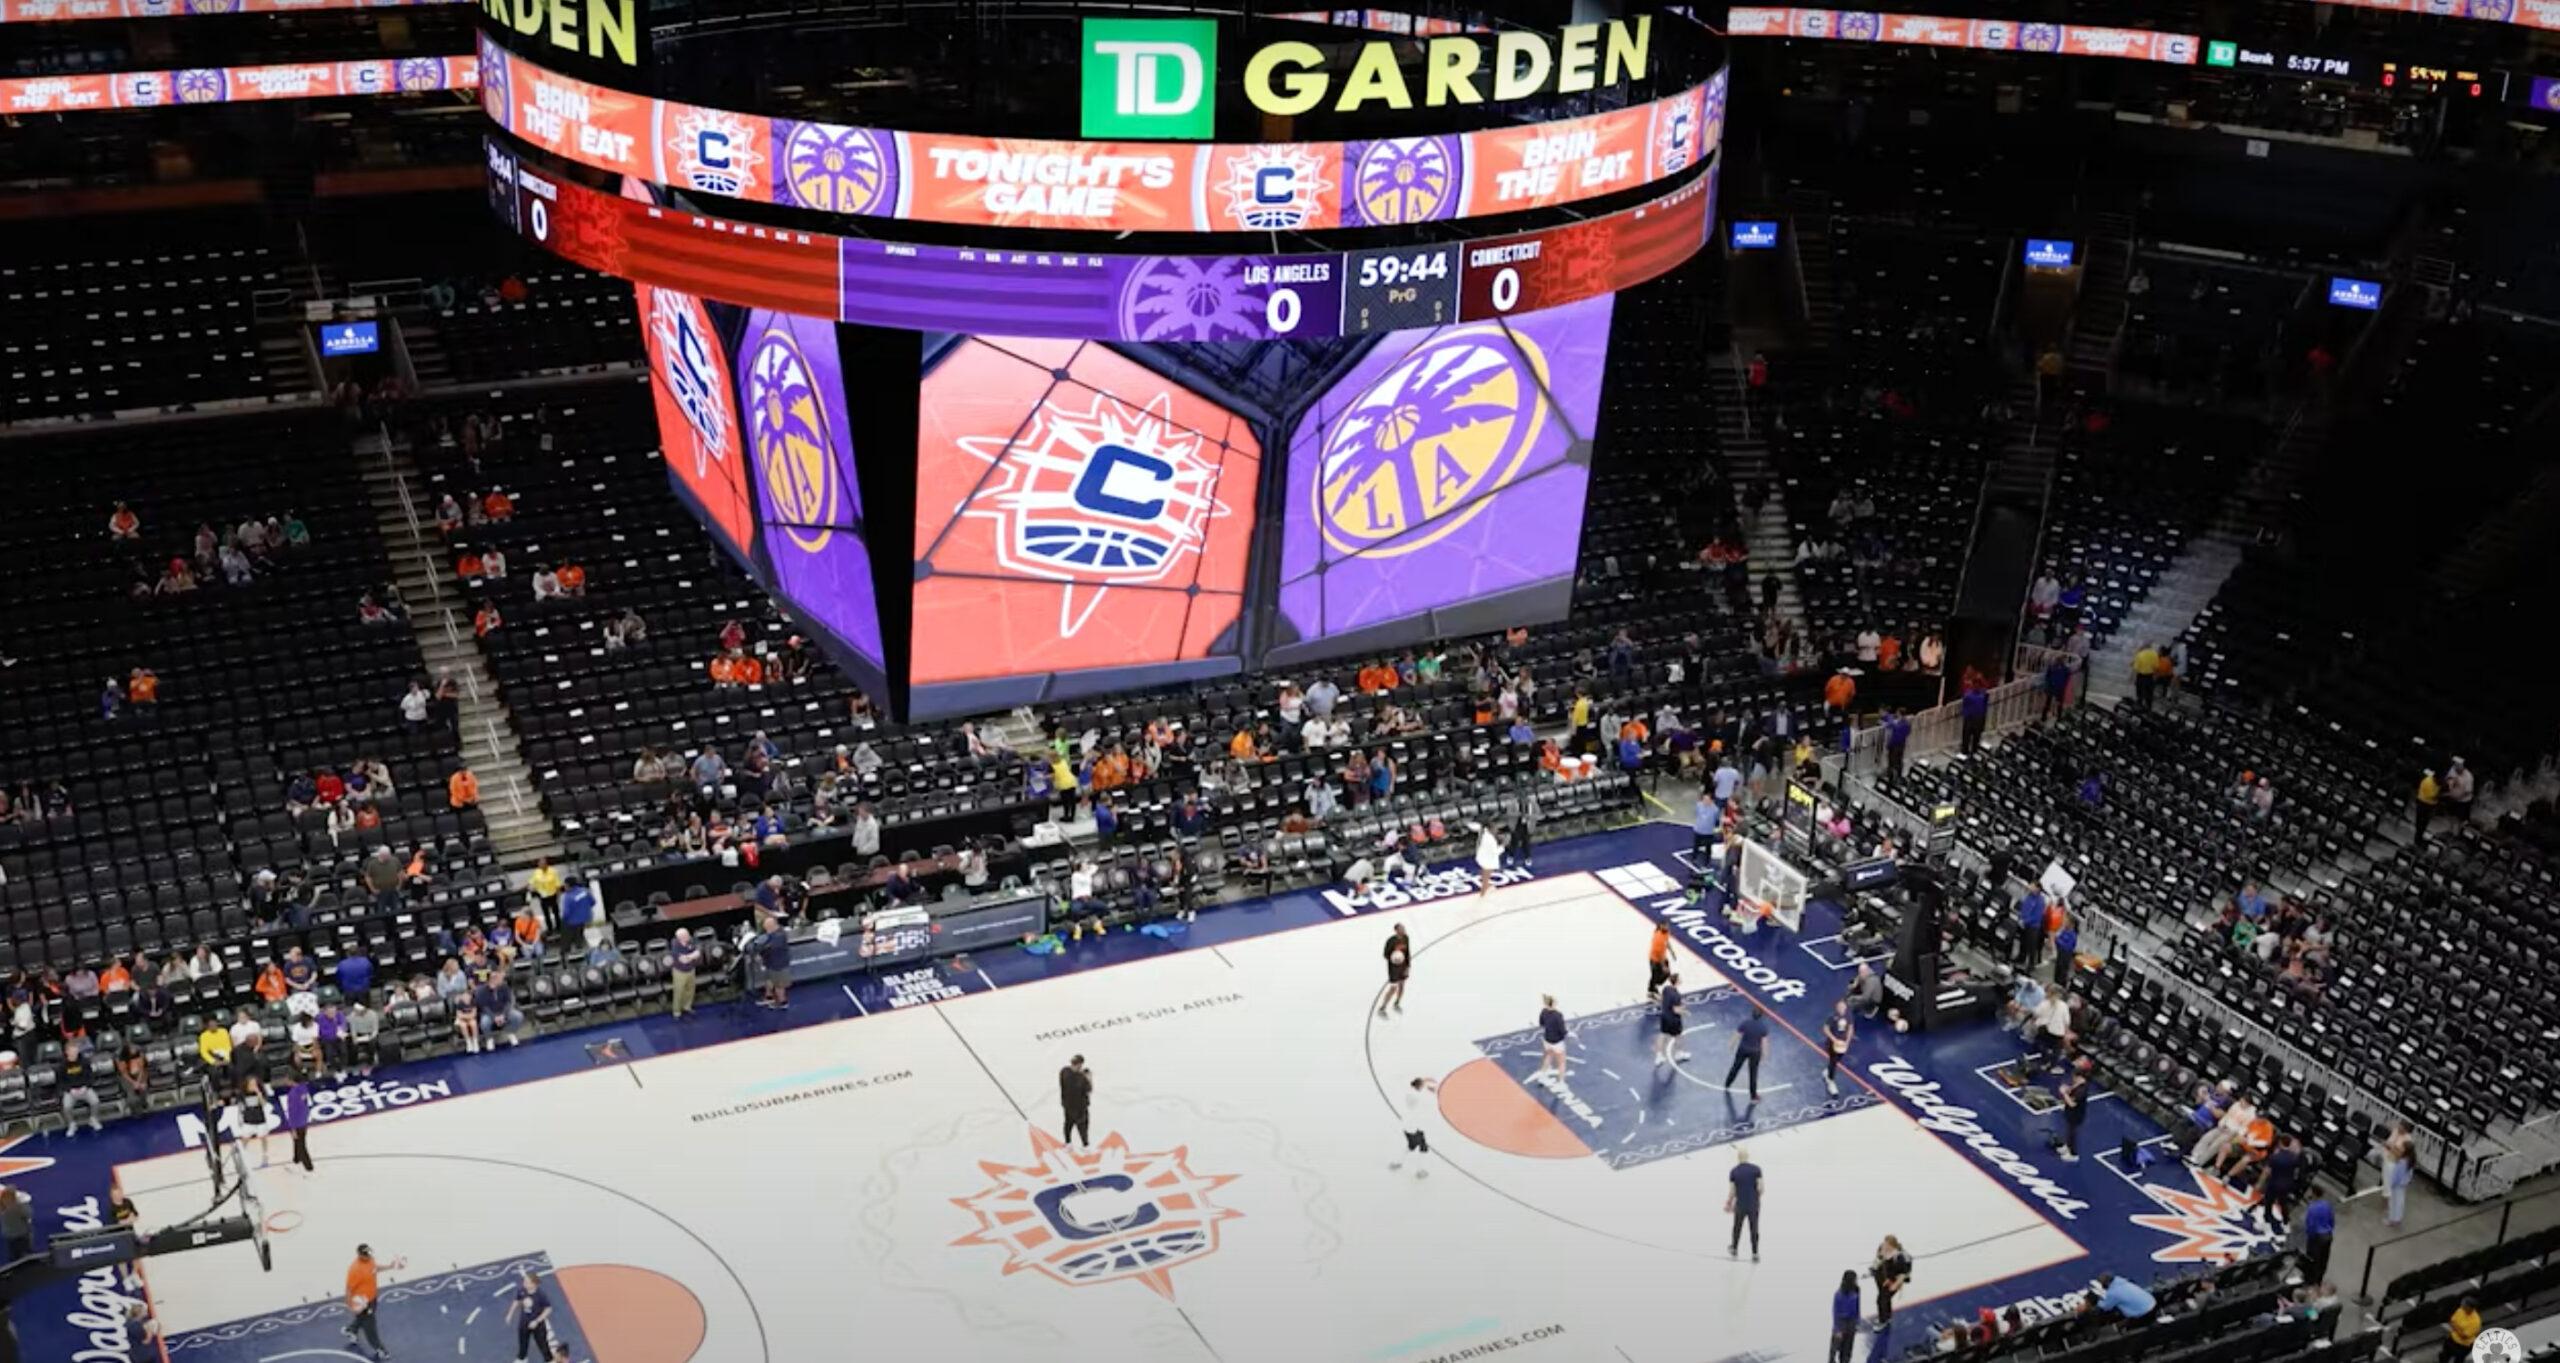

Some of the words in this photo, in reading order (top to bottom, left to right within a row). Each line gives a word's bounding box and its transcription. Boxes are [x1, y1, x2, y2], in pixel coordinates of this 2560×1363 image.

[1095, 41, 1204, 115] TD
[1243, 15, 1652, 115] GARDEN
[2239, 50, 2274, 65] Bank
[2287, 54, 2321, 72] 5:57
[2323, 59, 2350, 75] PM
[533, 80, 590, 123] BRIN
[522, 103, 562, 144] THE
[578, 128, 634, 163] EAT
[1522, 130, 1598, 168] BRIN
[928, 149, 1175, 189] TONIGHT'S
[1495, 166, 1559, 201] THE
[1581, 150, 1633, 187] EAT
[532, 198, 547, 242] 0
[982, 184, 1117, 216] GAME
[1245, 265, 1270, 285] LOS
[1273, 263, 1330, 283] ANGELES
[1359, 252, 1449, 287] 59:44
[1471, 240, 1543, 269] CONNECTICUT
[1266, 288, 1302, 333] 0
[1389, 288, 1417, 303] PrG
[1492, 268, 1520, 312] 0
[1651, 897, 1807, 1003] Microsoft
[882, 967, 935, 986] BLACK
[889, 985, 965, 1008] MATTER
[894, 979, 944, 996] LIVES
[1035, 1015, 1132, 1042] MOHEGAN
[1137, 1007, 1177, 1021] SUN
[1183, 993, 1243, 1012] ARENA
[308, 1079, 450, 1123] OSTON
[691, 1070, 913, 1123] BUILDSUBMARINES.COM
[1868, 1055, 2090, 1219] Walgreens
